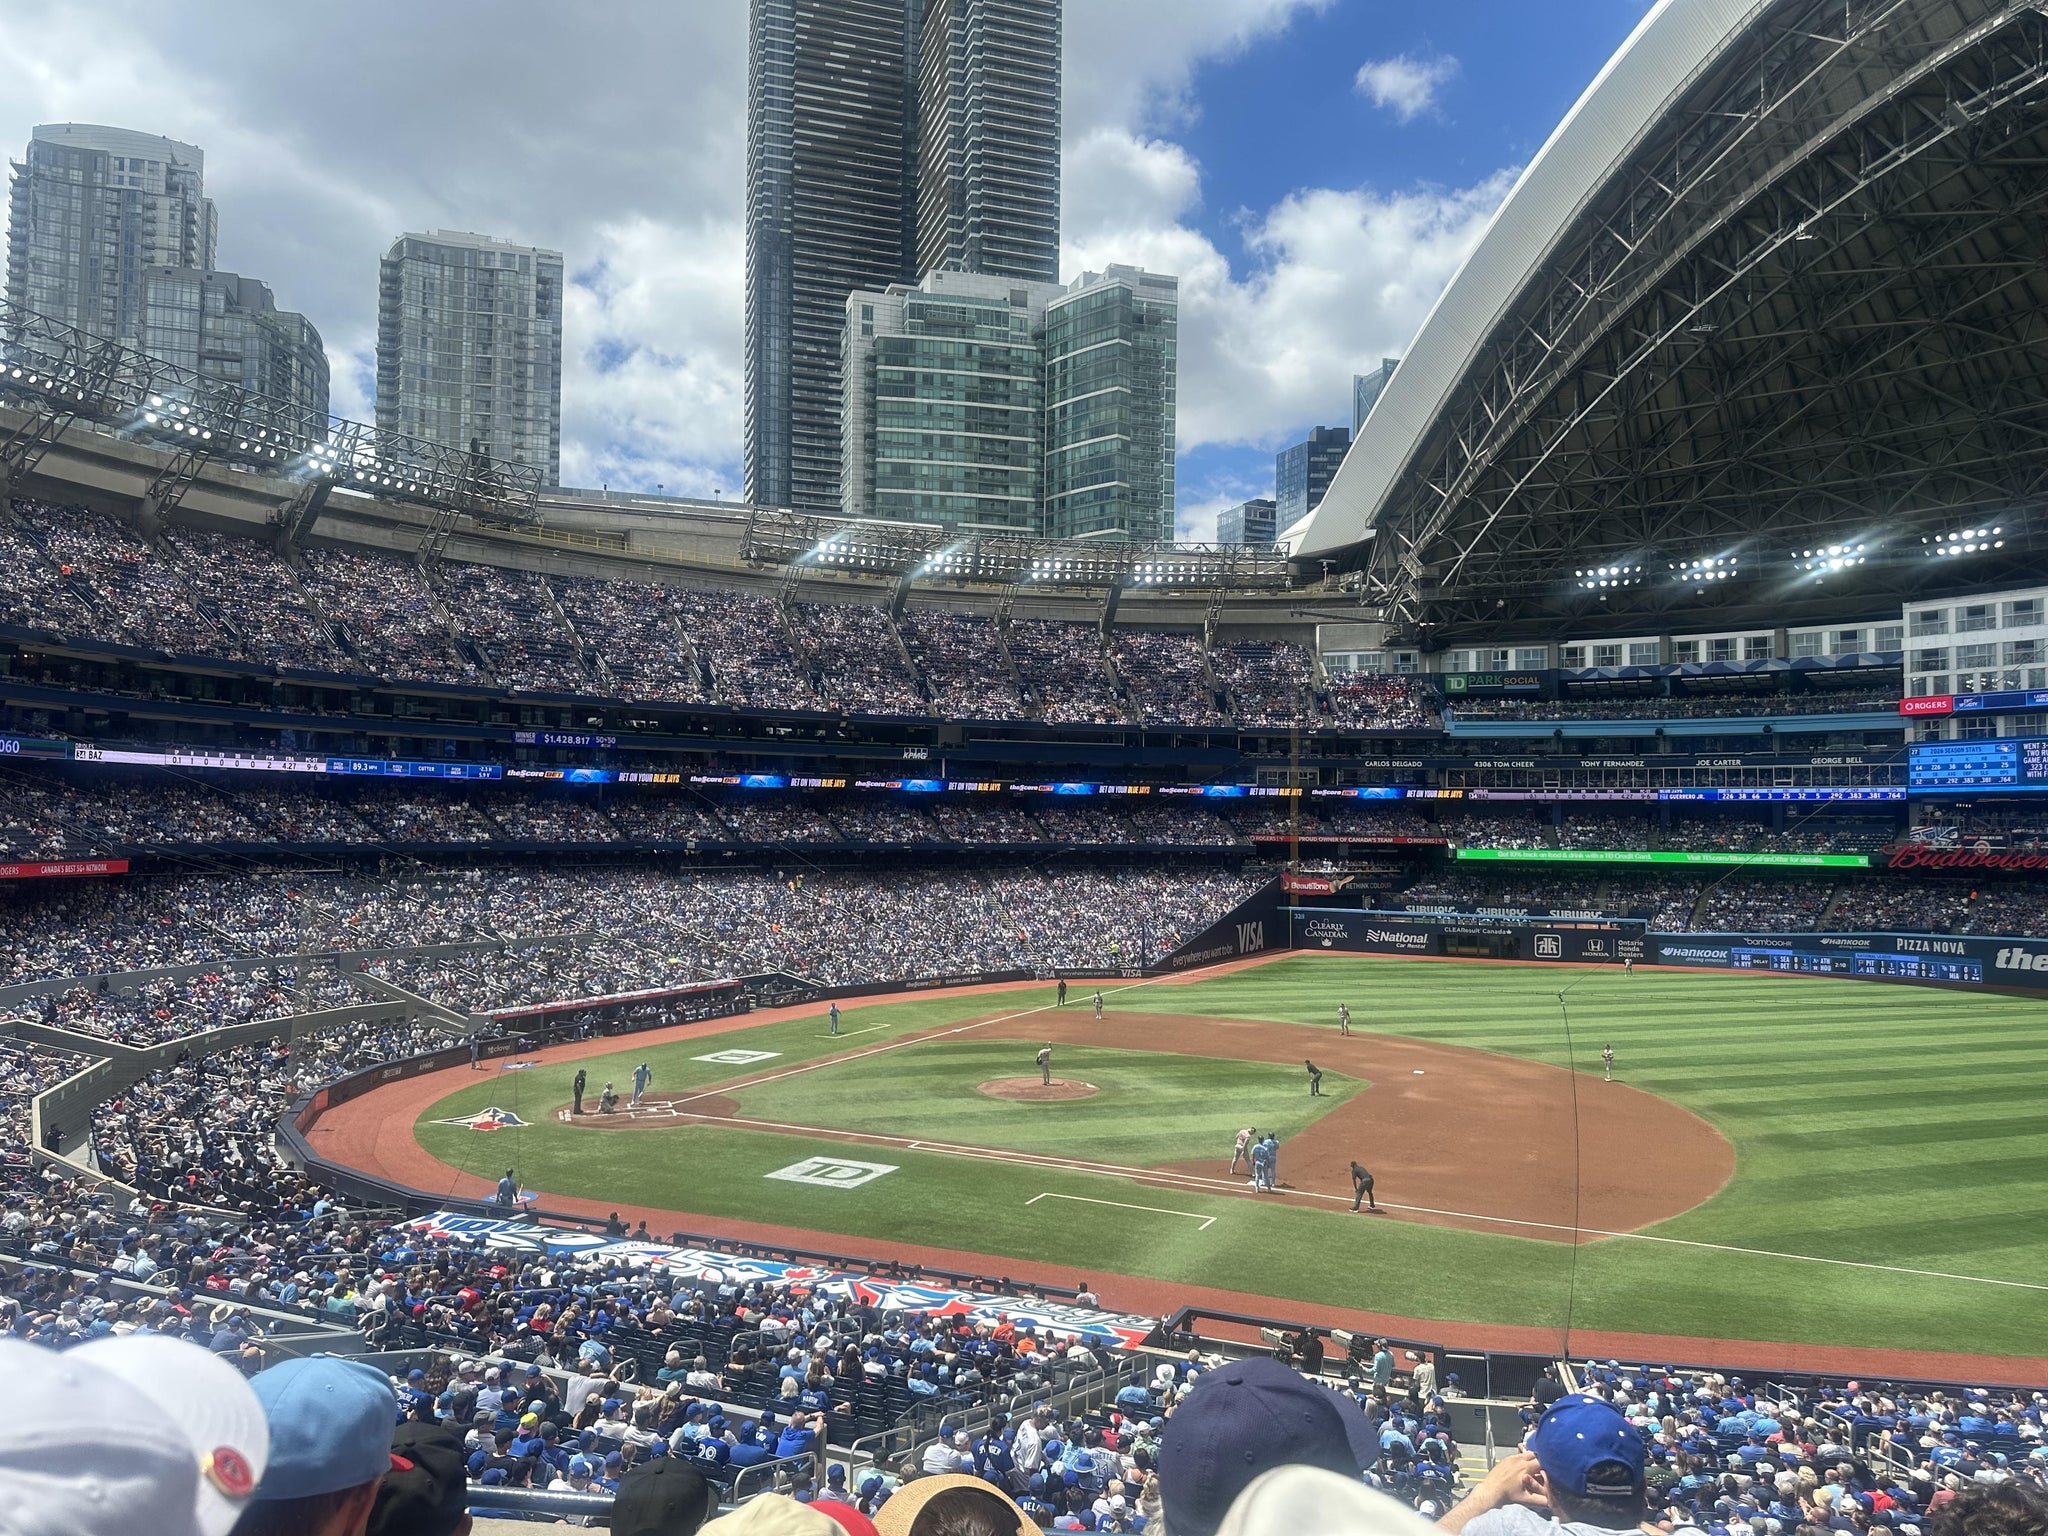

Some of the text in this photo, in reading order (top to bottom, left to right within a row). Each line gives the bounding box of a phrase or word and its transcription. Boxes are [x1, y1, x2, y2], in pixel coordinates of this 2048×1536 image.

[1448, 675, 1540, 689] TD PARK SOCIAL
[1915, 701, 1947, 710] ROGERS
[88, 750, 102, 760] BAZ
[903, 752, 927, 760] KPMG
[282, 762, 296, 770] 4.27
[353, 763, 368, 771] 89.3
[507, 769, 544, 778] theScore
[619, 772, 629, 782] BET
[629, 773, 638, 782] ON
[638, 773, 653, 782] YOUR
[653, 774, 666, 783] BLUE
[690, 775, 722, 783] theScore
[791, 778, 800, 786] BET
[800, 778, 808, 787] ON
[808, 779, 822, 787] YOUR
[822, 779, 834, 787] BLUE
[855, 780, 885, 788] theScore
[948, 782, 957, 790] BET
[958, 782, 965, 790] ON
[965, 782, 978, 791] YOUR
[978, 783, 989, 791] BLUE
[1115, 786, 1128, 794] YOUR
[1127, 786, 1139, 794] BLUE
[1258, 788, 1266, 796] ON
[1266, 788, 1279, 796] YOUR
[1279, 788, 1291, 796] BLUE
[1407, 789, 1416, 797] BET
[1416, 789, 1424, 797] ON
[1424, 789, 1438, 798] YOUR
[1438, 790, 1450, 798] BLUE
[40, 865, 64, 874] CANADA'S
[65, 864, 76, 873] BEST
[86, 864, 107, 872] NETWORK
[1291, 881, 1329, 891] BeautiTone
[1310, 920, 1344, 931] CLEARLY
[1236, 921, 1264, 953] VISA
[1305, 928, 1348, 939] CANADIAN
[1380, 932, 1427, 944] National
[1896, 938, 1965, 955] PIZZA NOVA
[1173, 944, 1233, 967] everywhere you want to be
[1121, 969, 1142, 977] VISA
[800, 1161, 874, 1180] TD
